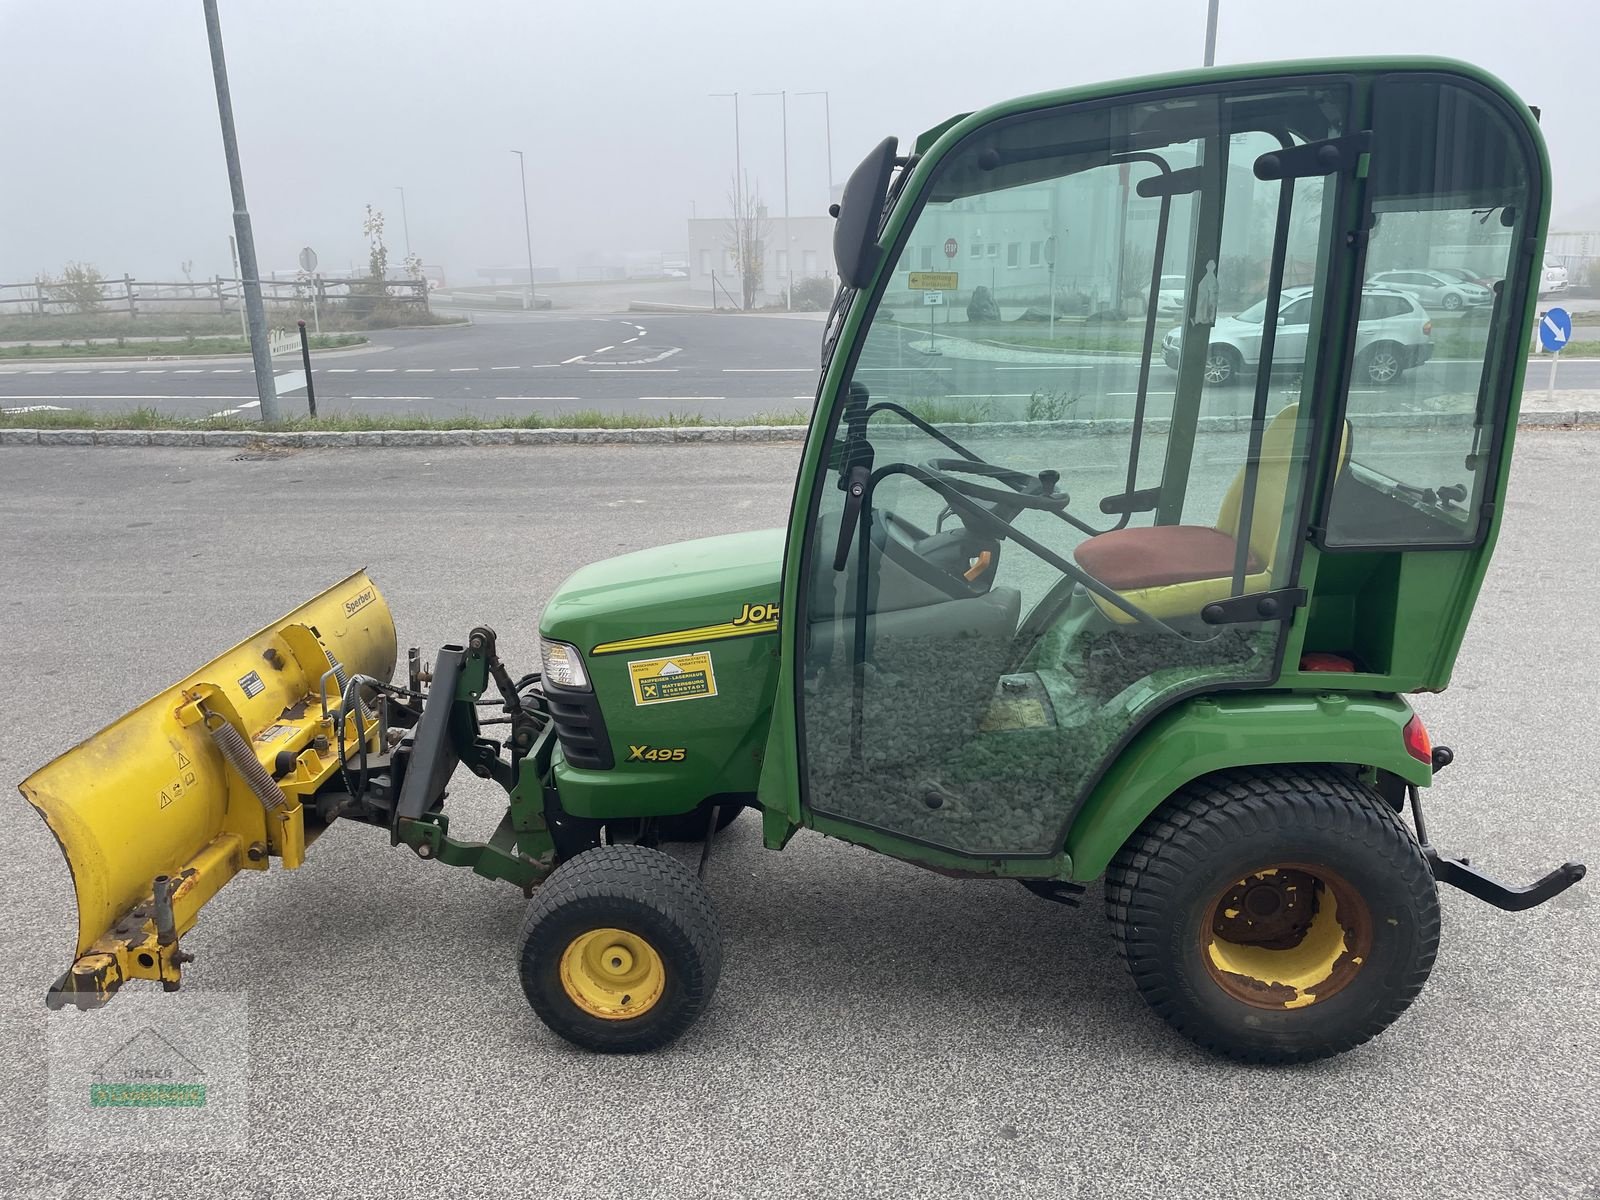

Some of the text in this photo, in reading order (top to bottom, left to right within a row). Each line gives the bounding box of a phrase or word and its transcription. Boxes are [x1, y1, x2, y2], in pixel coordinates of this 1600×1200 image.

[945, 243, 957, 253] STOP
[345, 591, 371, 613] Sperber
[662, 680, 704, 688] MATTERSBURG
[663, 685, 704, 693] EISENSTADT
[628, 745, 686, 761] X495
